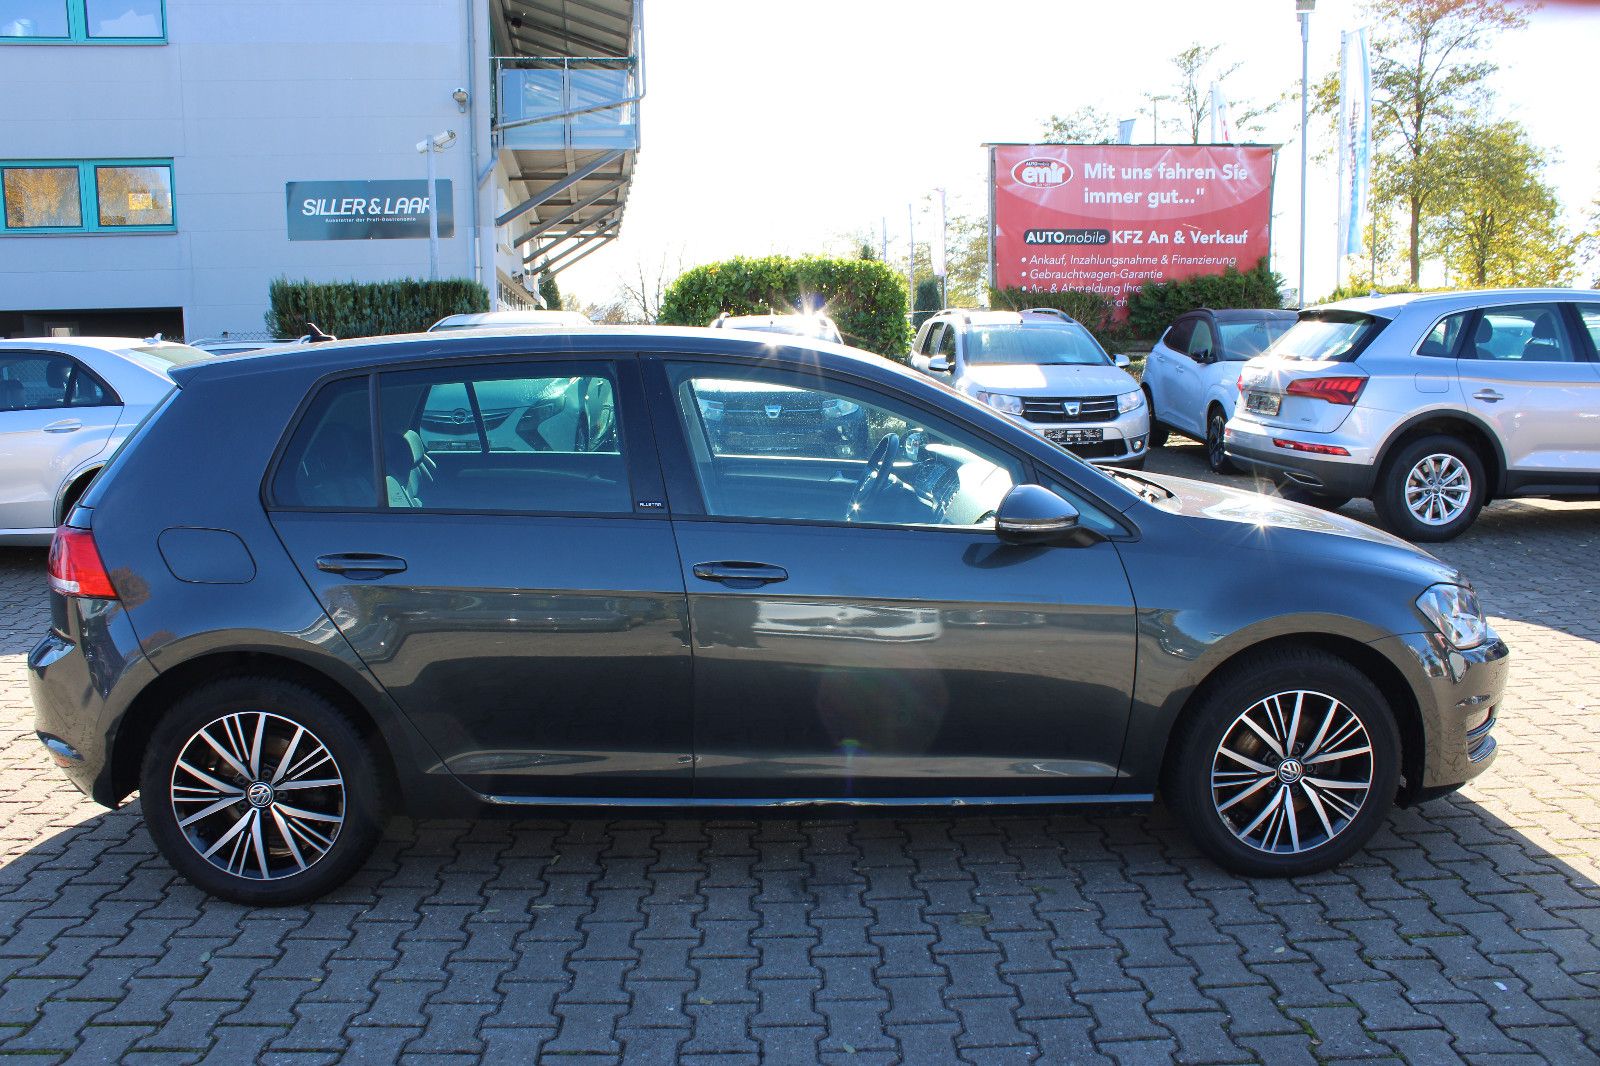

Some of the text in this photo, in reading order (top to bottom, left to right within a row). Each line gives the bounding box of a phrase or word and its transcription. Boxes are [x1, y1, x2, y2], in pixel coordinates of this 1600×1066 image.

[1021, 162, 1065, 184] emir
[1084, 163, 1248, 181] Mit uns fahren Sie
[1084, 188, 1142, 204] immer
[302, 198, 367, 216] SILLER
[368, 198, 382, 215] &
[1025, 230, 1249, 244] AUTOmobile KFZ An & Verkauf
[1029, 254, 1237, 267] Ankauf, Inzahlungsnahme & Finanzierung
[1029, 269, 1163, 281] Gebrauchtwagen-Garantie
[1050, 283, 1059, 294] &
